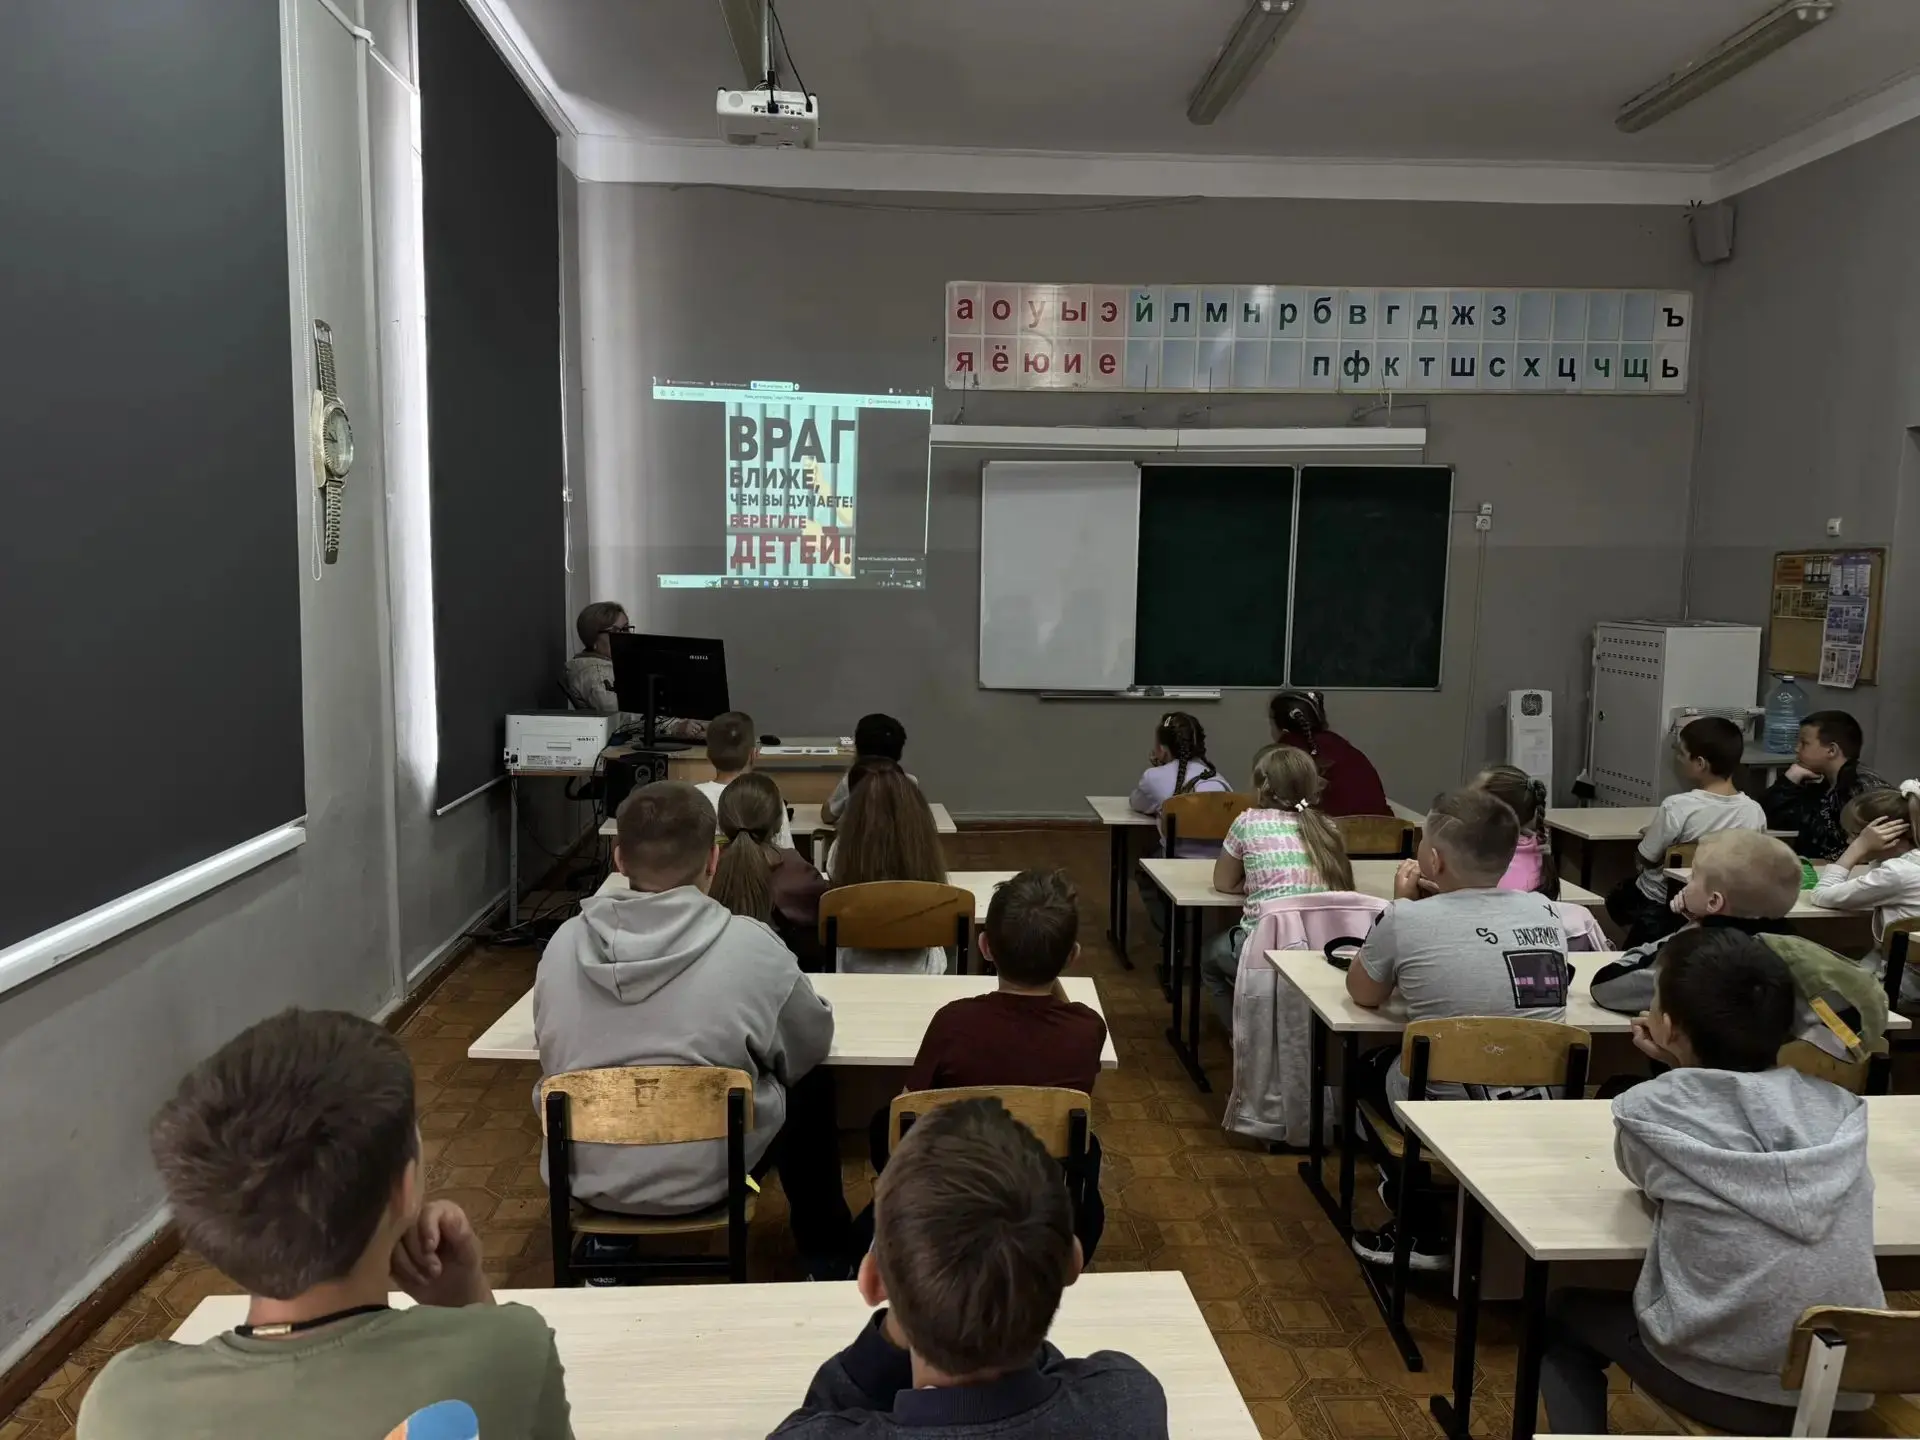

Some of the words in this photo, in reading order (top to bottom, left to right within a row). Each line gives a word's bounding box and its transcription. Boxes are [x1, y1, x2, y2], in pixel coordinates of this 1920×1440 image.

[956, 299, 973, 320] а
[992, 300, 1011, 320] о
[1061, 301, 1086, 322] ы
[1101, 302, 1117, 322] э
[1136, 294, 1153, 322] й
[1170, 302, 1190, 322] л
[1205, 302, 1227, 322] м
[1243, 302, 1260, 322] н
[1279, 302, 1297, 330] р
[1313, 297, 1332, 324] б
[1349, 305, 1367, 324] в
[1387, 305, 1400, 325] г
[1417, 305, 1438, 330] д
[1452, 306, 1475, 325] ж
[1491, 306, 1507, 326] з
[956, 351, 973, 372] я
[992, 345, 1009, 372] ё
[1024, 352, 1049, 373] ю
[1064, 352, 1081, 373] и
[1099, 353, 1116, 373] е
[1313, 357, 1329, 376] п
[1343, 350, 1370, 383] ф
[1384, 357, 1400, 377] к
[1419, 358, 1435, 377] т
[1450, 358, 1475, 377] ш
[1489, 357, 1506, 377] с
[1523, 357, 1541, 377] х
[1558, 358, 1576, 382] ц
[1594, 358, 1610, 377] ч
[1623, 358, 1649, 382] щ
[729, 416, 855, 463] ВРАГ
[730, 467, 820, 493] БЛИЖЕ,
[730, 493, 759, 506] ЧЕМ
[763, 494, 782, 506] ВЫ
[787, 495, 853, 509] ДУМАЕТЕ!
[730, 514, 807, 528] БЕРЕГИТЕ
[730, 526, 853, 569] ДЕТЕЙ!
